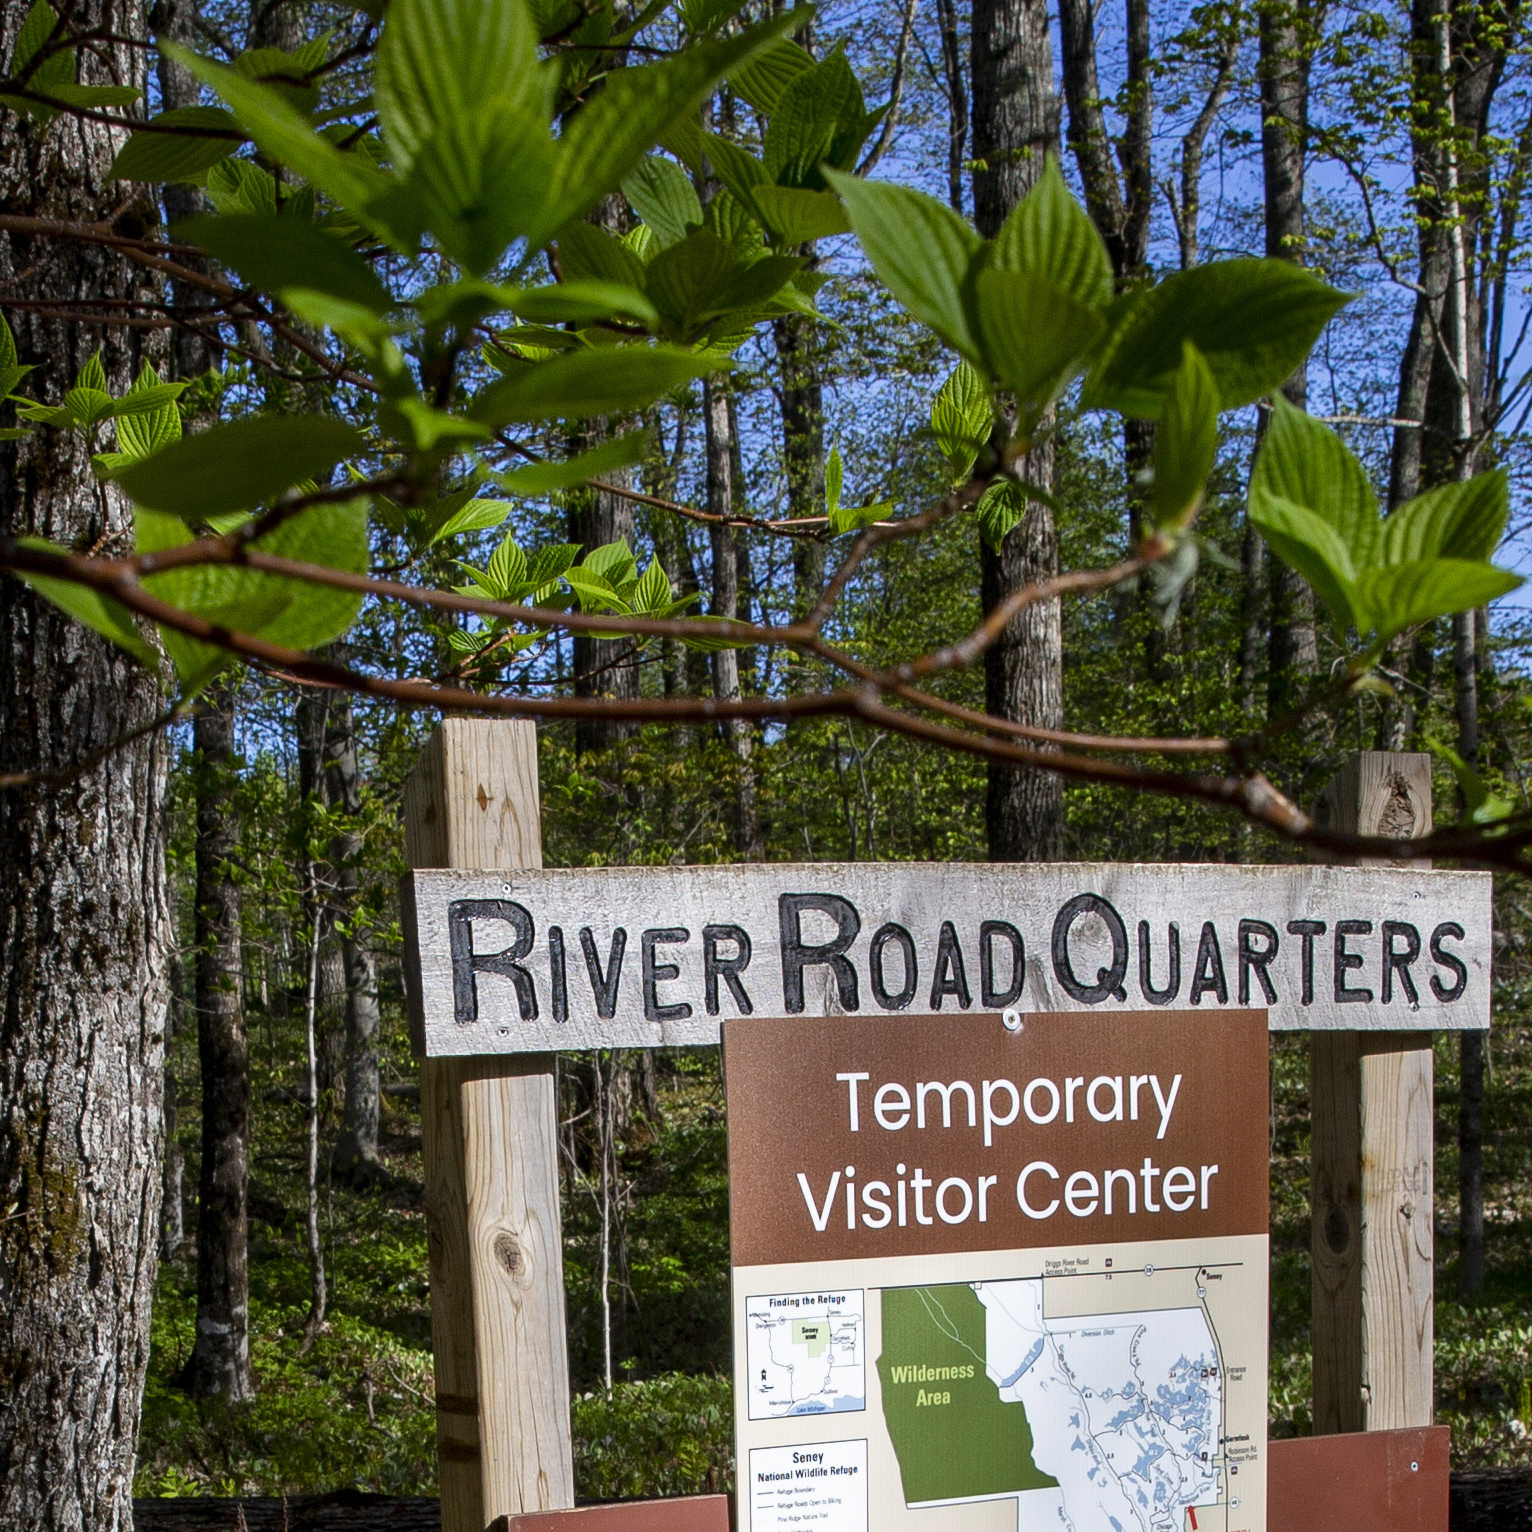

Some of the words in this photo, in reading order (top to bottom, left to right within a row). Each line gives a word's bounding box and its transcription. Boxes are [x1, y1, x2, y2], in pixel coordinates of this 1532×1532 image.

[448, 898, 754, 1026] RIVER
[778, 892, 1026, 1013] ROAD
[1051, 892, 1469, 1005] QUARTERS
[835, 1072, 1182, 1147] Temporary
[797, 1163, 997, 1232] Visitor
[1016, 1157, 1218, 1220] Center
[1076, 1257, 1090, 1266] Road
[769, 1298, 800, 1307] Finding
[802, 1296, 815, 1305] the
[818, 1295, 846, 1304] Refuge
[891, 1364, 975, 1384] Wilderness
[916, 1389, 951, 1407] Area
[792, 1452, 824, 1465] Seney
[758, 1471, 793, 1482] National
[795, 1467, 828, 1479] Wildlife
[830, 1465, 858, 1476] Refuge
